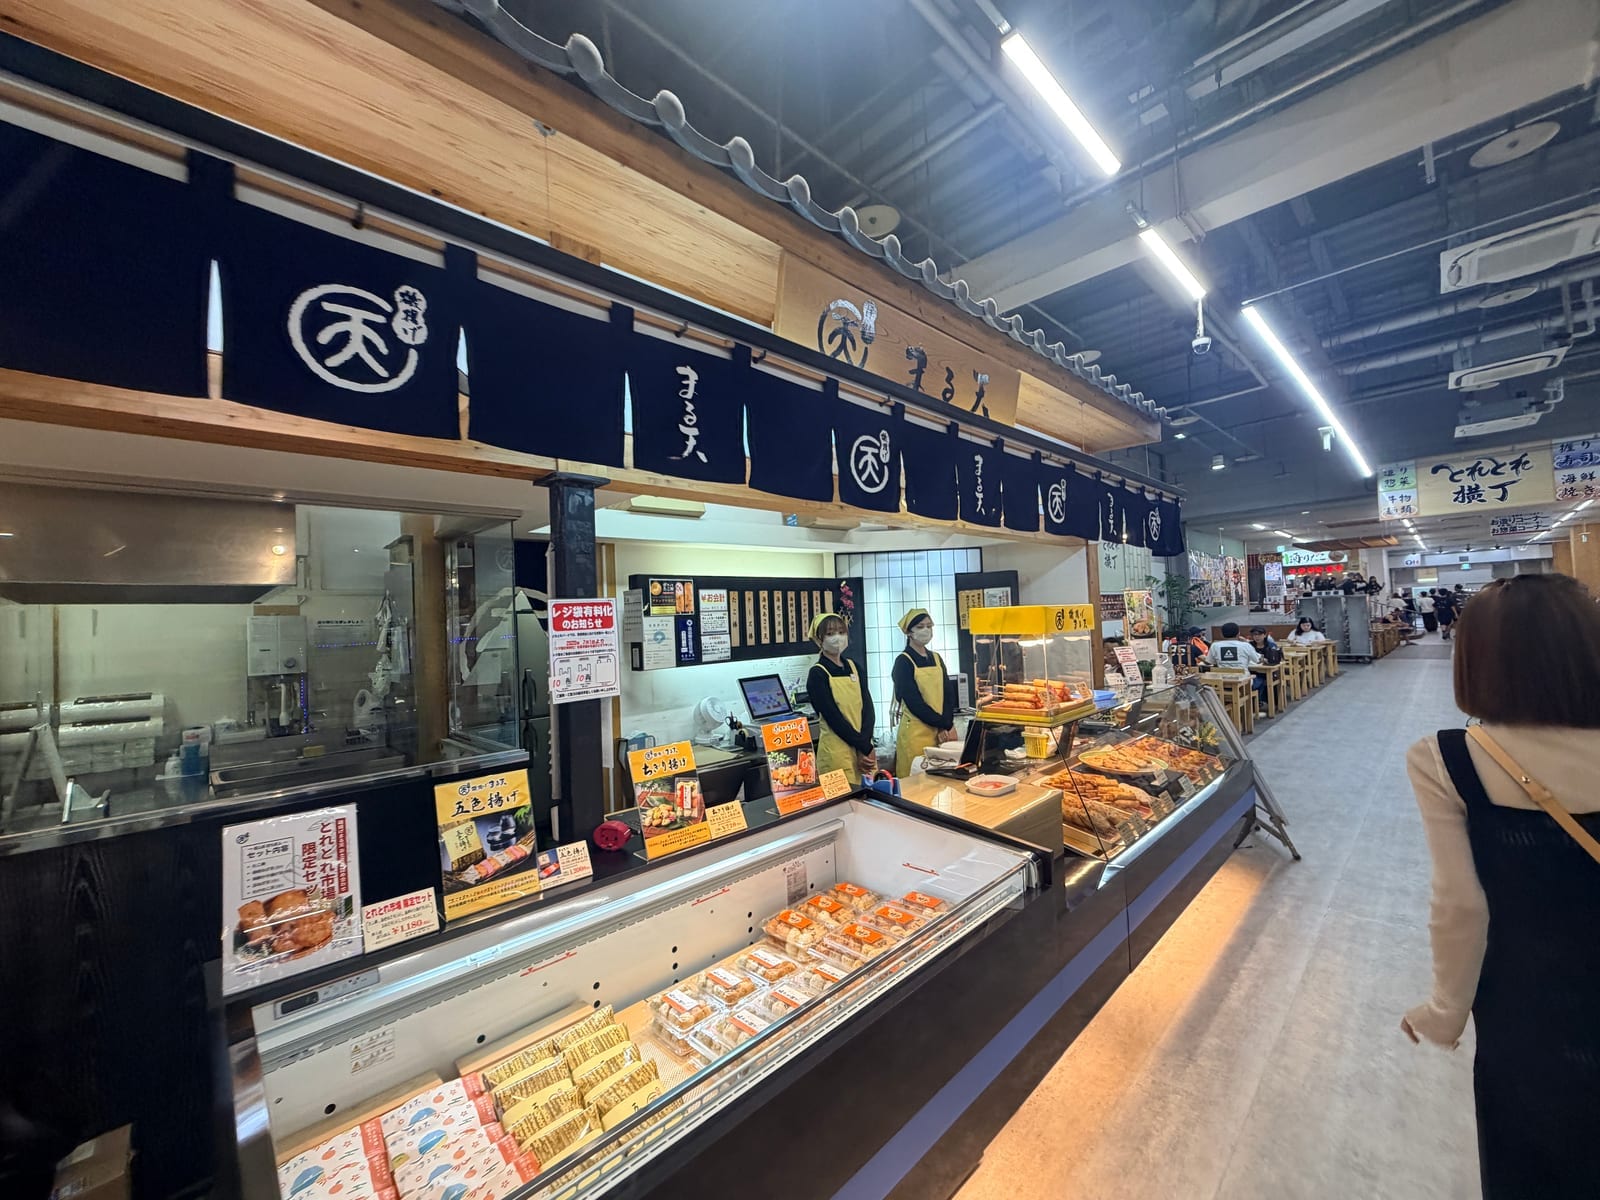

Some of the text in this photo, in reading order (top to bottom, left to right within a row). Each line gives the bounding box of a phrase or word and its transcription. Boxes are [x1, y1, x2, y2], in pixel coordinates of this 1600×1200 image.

[665, 364, 709, 463] まる天
[1431, 452, 1534, 483] とれとれ
[1561, 471, 1597, 485] 海鮮
[974, 454, 986, 516] まる天
[1452, 478, 1523, 504] 横丁
[552, 605, 613, 618] レジ袋有料化
[562, 618, 603, 630] のお知らせ
[773, 732, 803, 745] つどい
[450, 789, 519, 818] 五色揚げ
[246, 845, 290, 859] セット内容
[318, 821, 337, 901] とれとれ市場
[301, 842, 318, 900] 限定セッ
[365, 900, 402, 919] とれとれ市場
